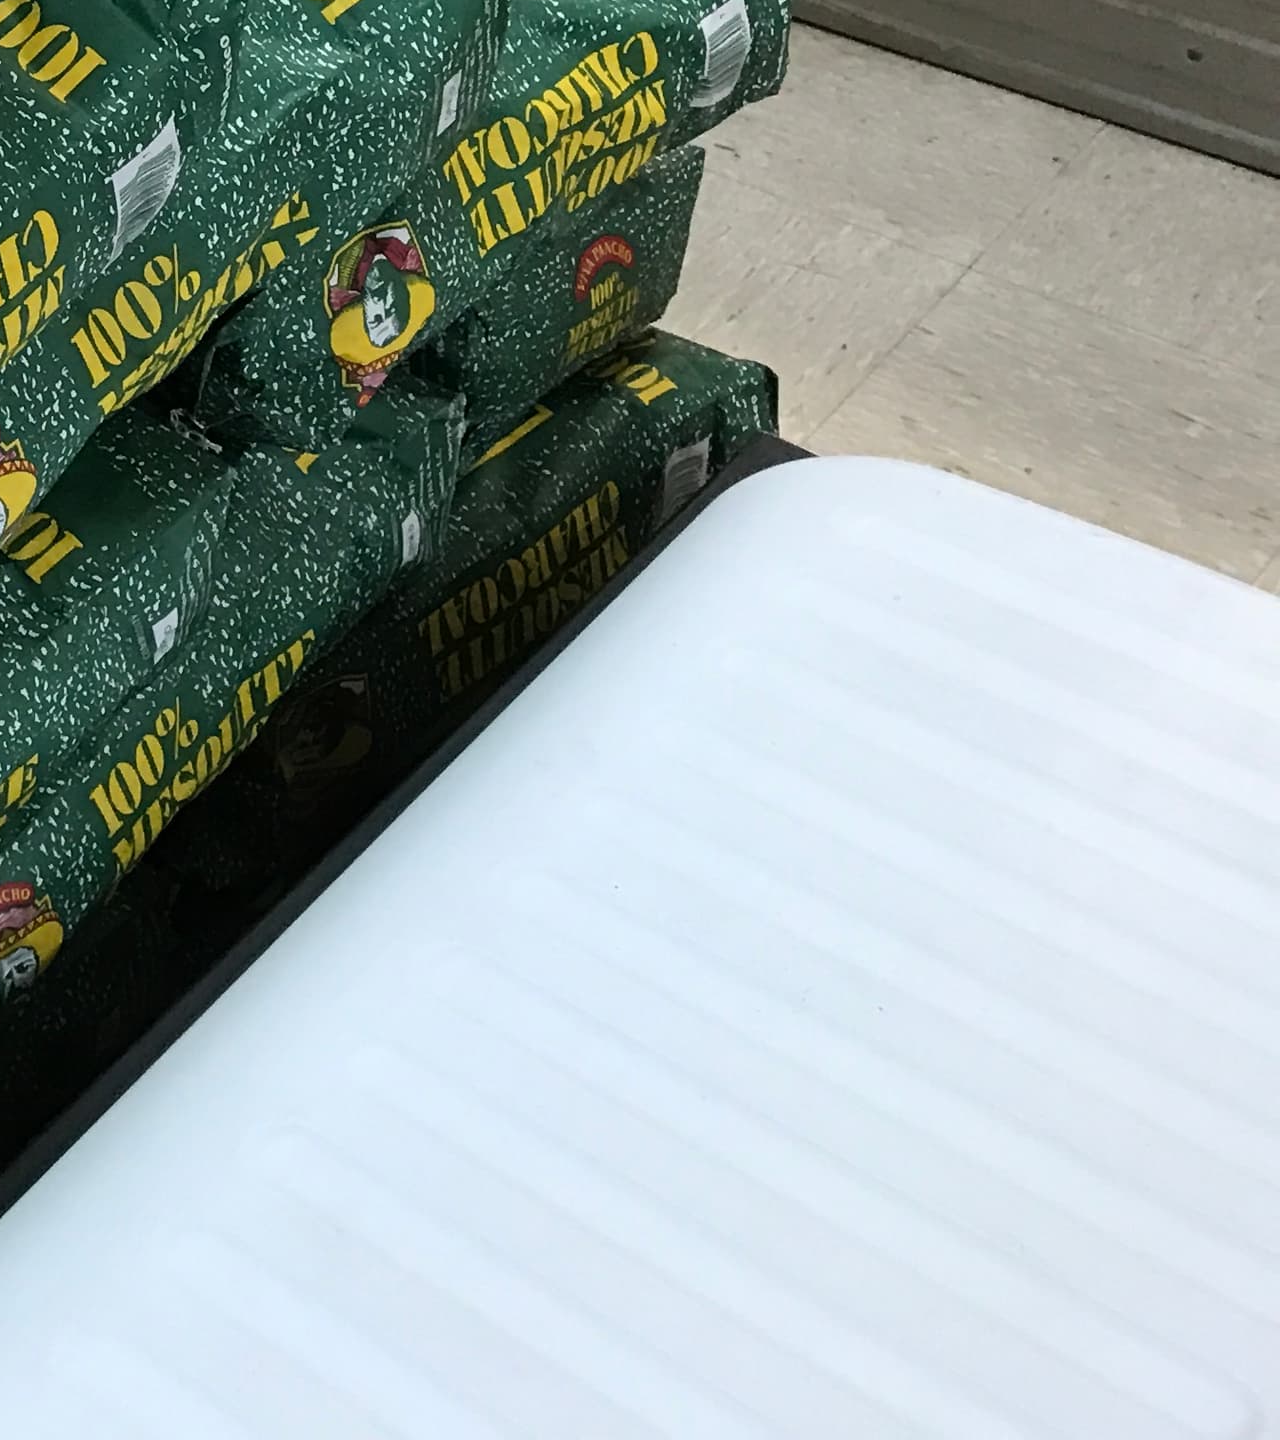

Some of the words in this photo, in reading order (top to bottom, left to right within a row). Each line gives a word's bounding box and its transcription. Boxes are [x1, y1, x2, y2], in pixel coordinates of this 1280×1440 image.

[444, 31, 659, 206] CHARCOAL
[470, 79, 667, 259] MESQUITE
[69, 243, 202, 388] 100%
[89, 696, 200, 836] 100%
